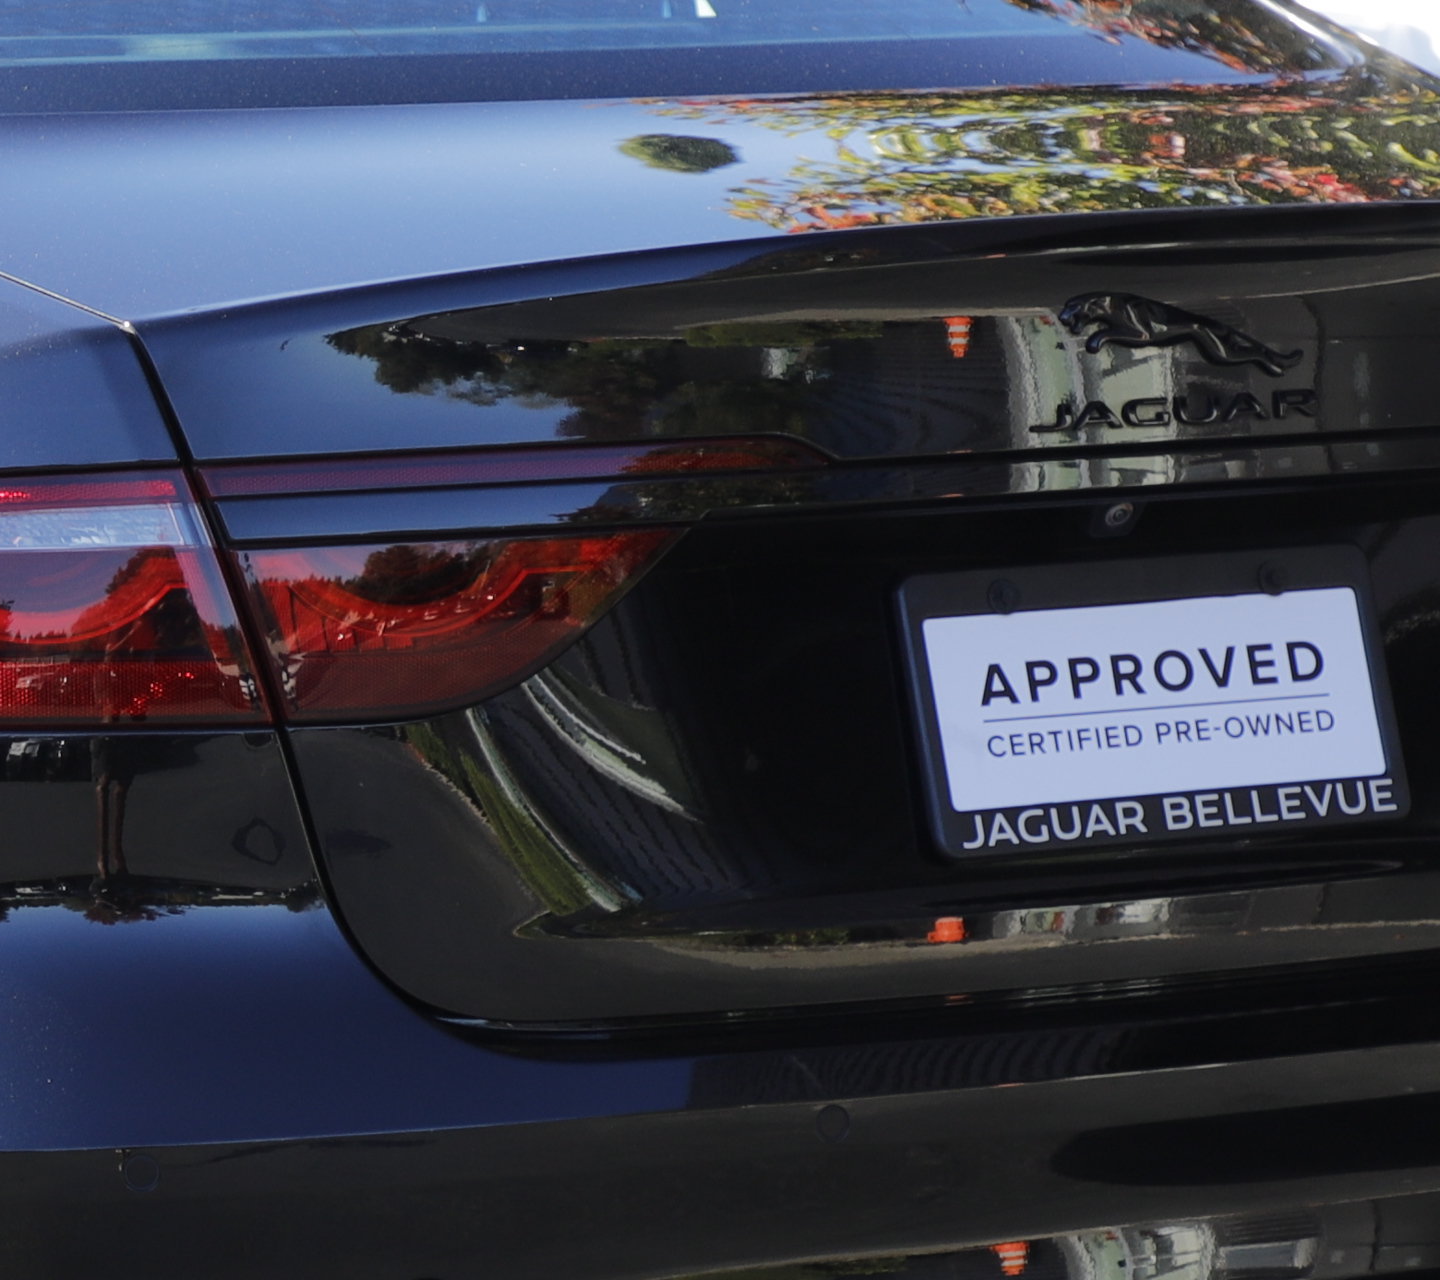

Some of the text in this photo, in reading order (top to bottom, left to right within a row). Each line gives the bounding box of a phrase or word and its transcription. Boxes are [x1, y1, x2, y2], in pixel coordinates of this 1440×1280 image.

[1029, 388, 1318, 433] JAGUAR
[980, 641, 1325, 707] APPROVED
[986, 710, 1335, 758] CERTIFIED PRE-OWNED
[962, 779, 1398, 850] JAGUAR BELLEVUE
